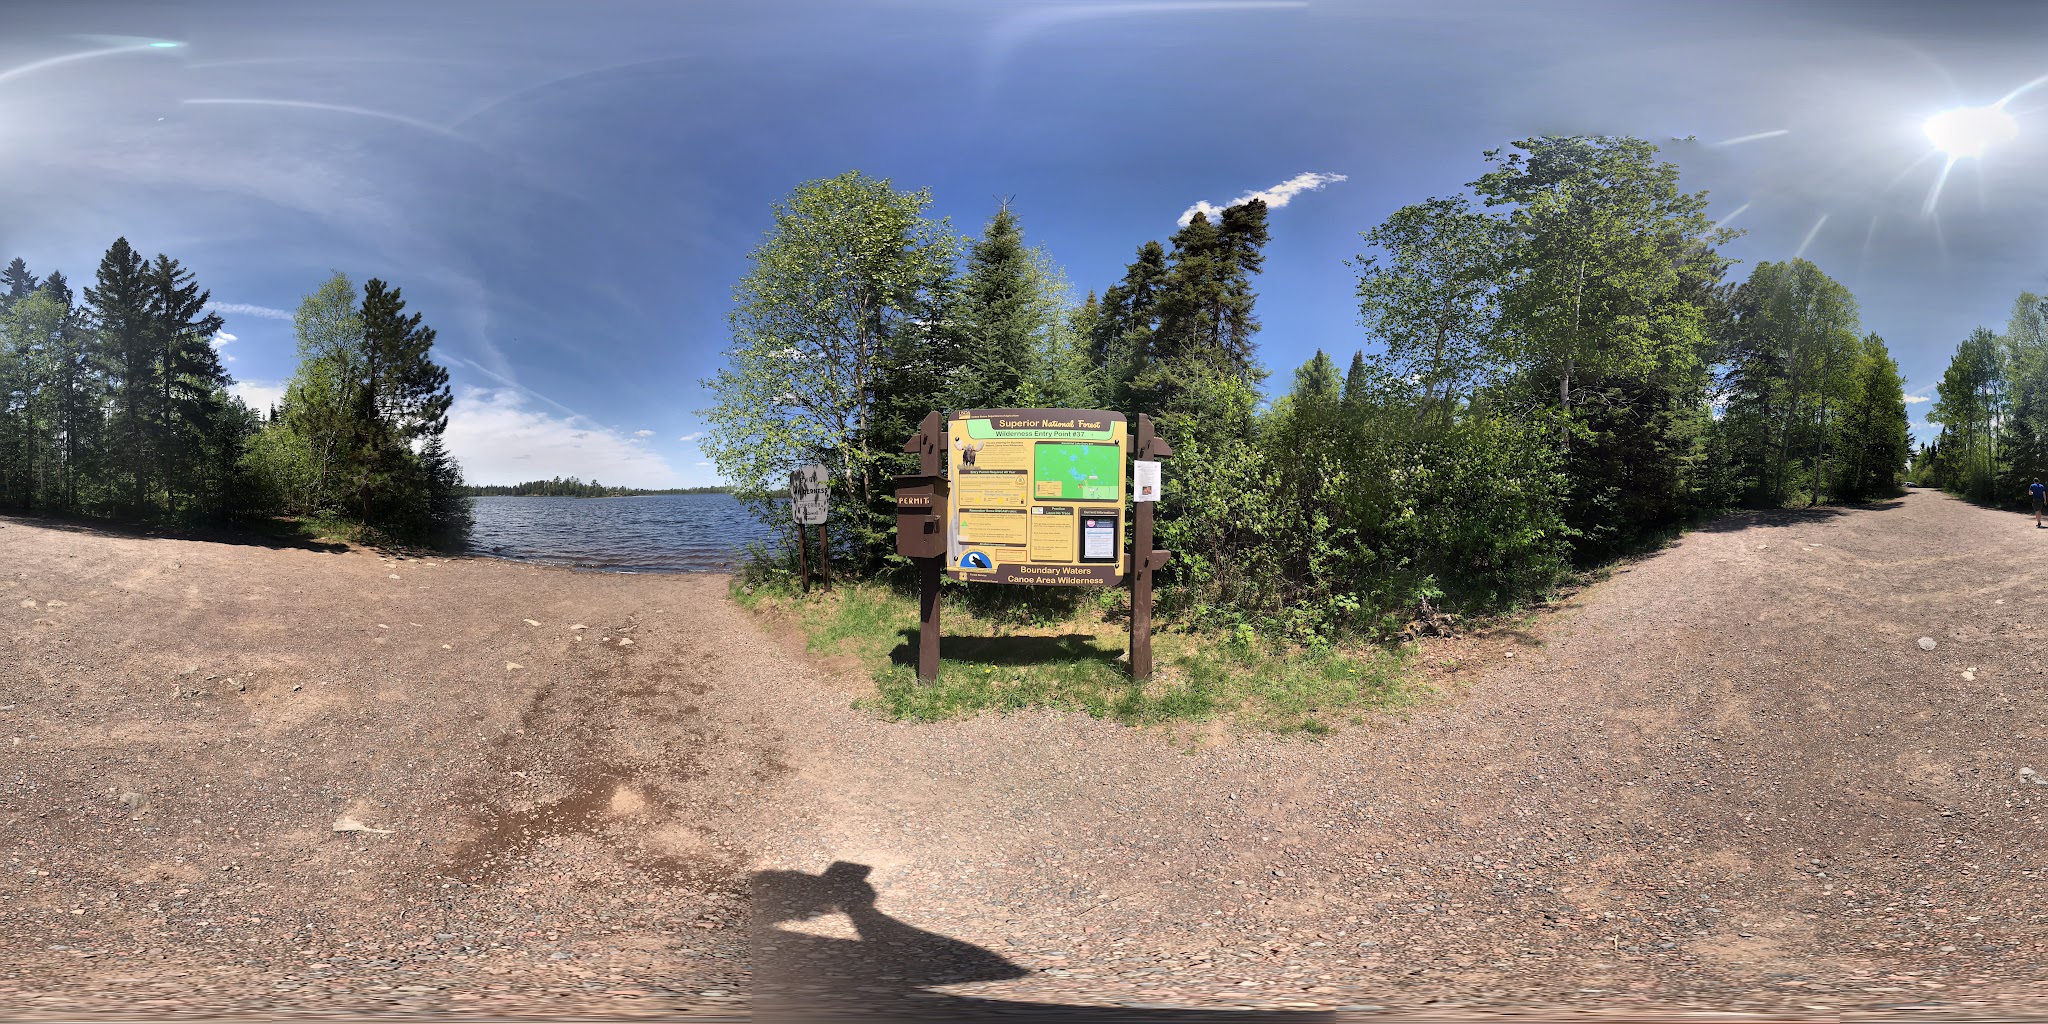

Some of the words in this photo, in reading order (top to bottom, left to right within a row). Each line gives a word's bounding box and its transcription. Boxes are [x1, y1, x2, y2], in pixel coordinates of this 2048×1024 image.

[999, 420, 1040, 428] Superior
[1042, 420, 1074, 428] National
[1078, 420, 1102, 428] Forest
[1020, 566, 1060, 576] Boundary
[1036, 576, 1056, 584] Area
